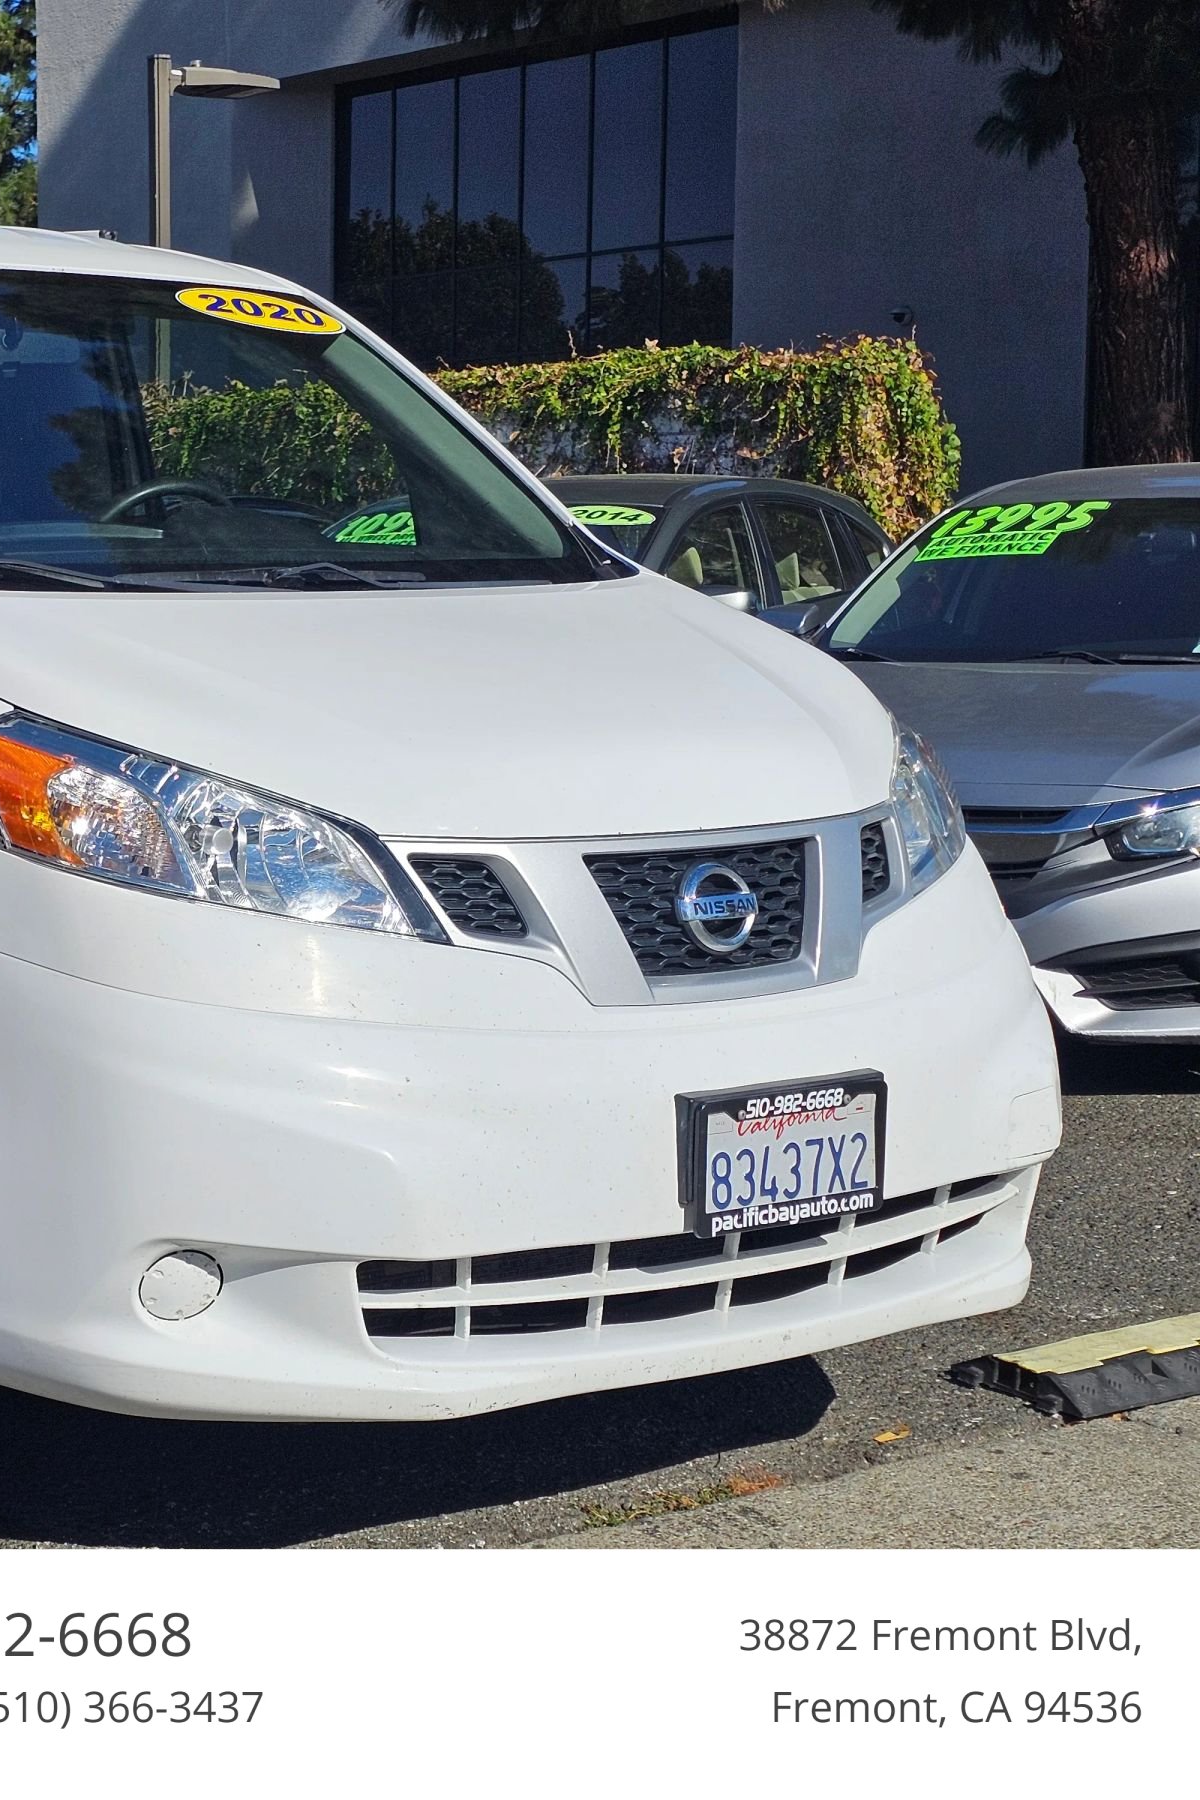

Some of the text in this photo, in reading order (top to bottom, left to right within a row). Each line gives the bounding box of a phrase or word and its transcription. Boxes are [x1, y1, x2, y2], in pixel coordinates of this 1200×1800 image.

[198, 294, 326, 327] 2020
[571, 509, 644, 522] 2014
[931, 501, 1111, 538] 13995
[920, 542, 1043, 560] WE FINANCE
[929, 532, 1054, 548] AUTOMATIC
[693, 898, 755, 915] NISSAN
[745, 1087, 845, 1120] 510-982-6668
[737, 1108, 848, 1141] California
[711, 1132, 868, 1211] 83437X2
[711, 1193, 874, 1238] pacificbayauto.com
